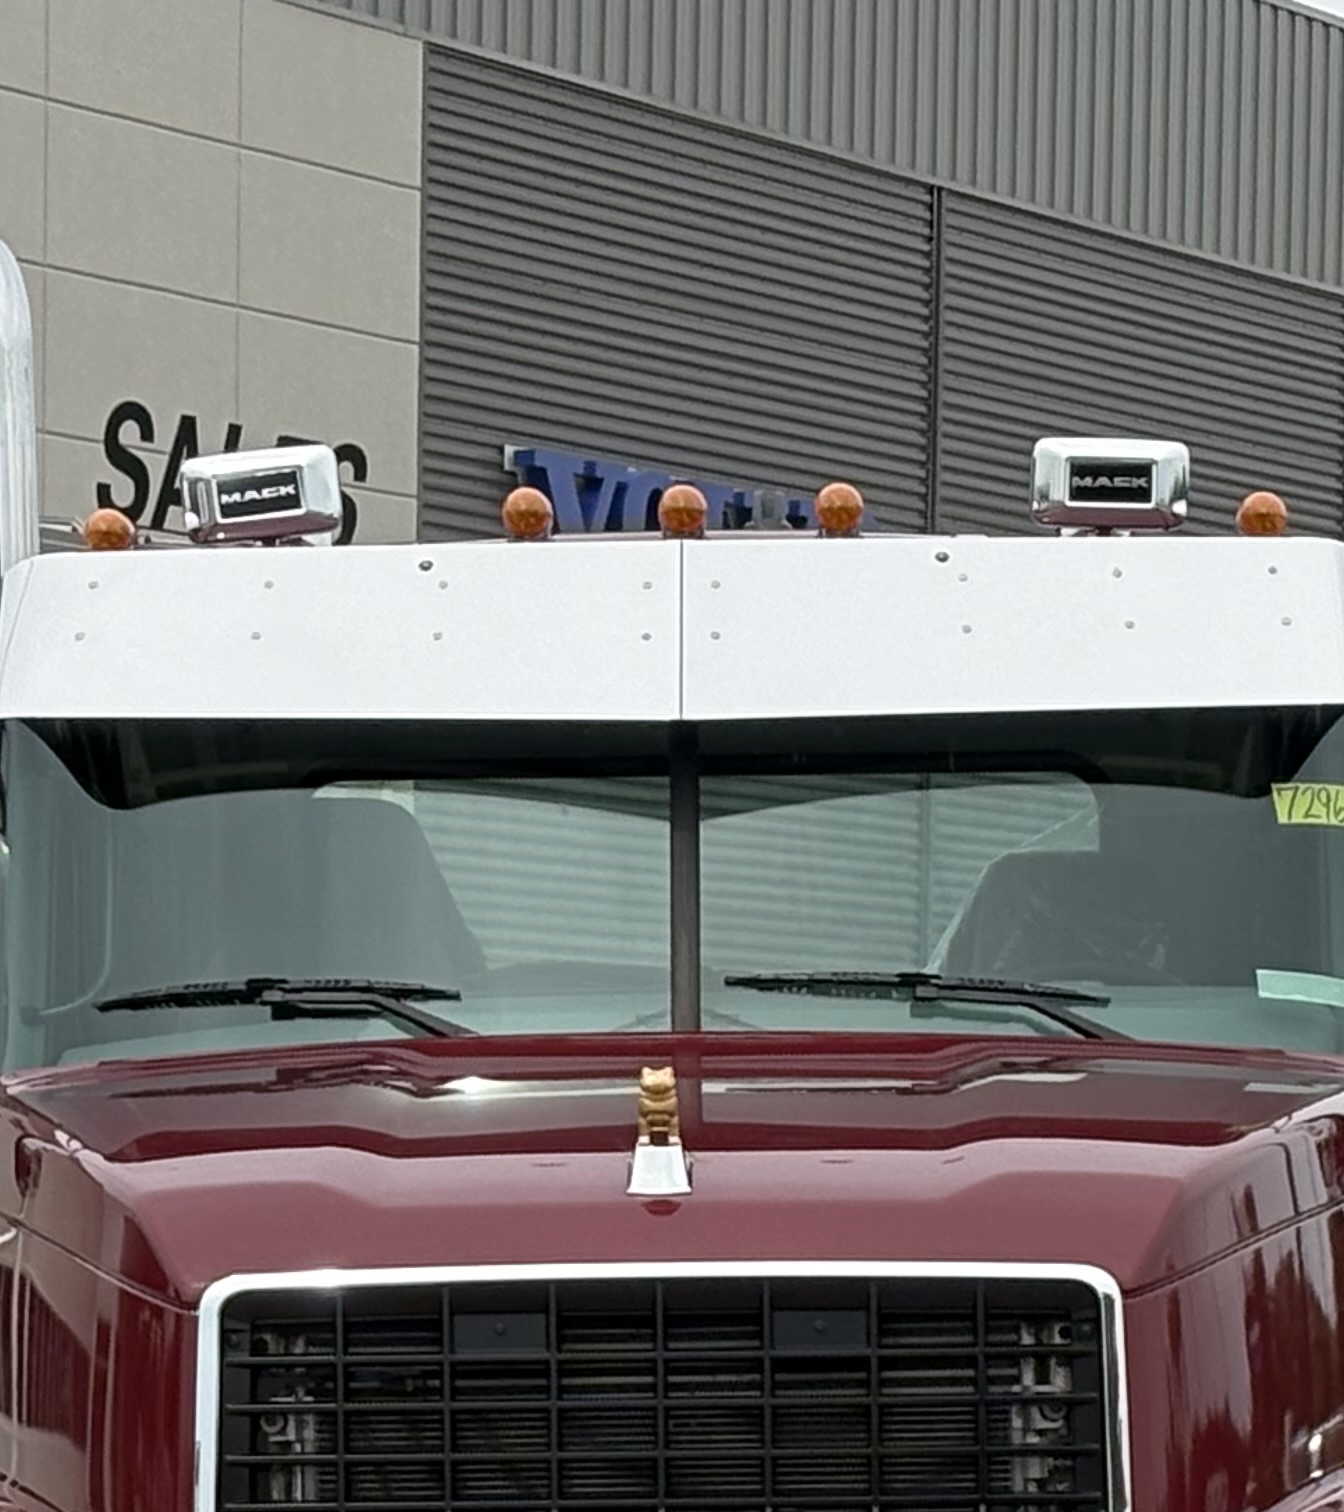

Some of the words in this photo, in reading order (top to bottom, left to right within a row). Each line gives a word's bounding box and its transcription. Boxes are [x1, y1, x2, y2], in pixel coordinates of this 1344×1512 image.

[96, 401, 367, 546] SAS
[1071, 475, 1149, 489] MACK
[220, 483, 296, 505] MACK
